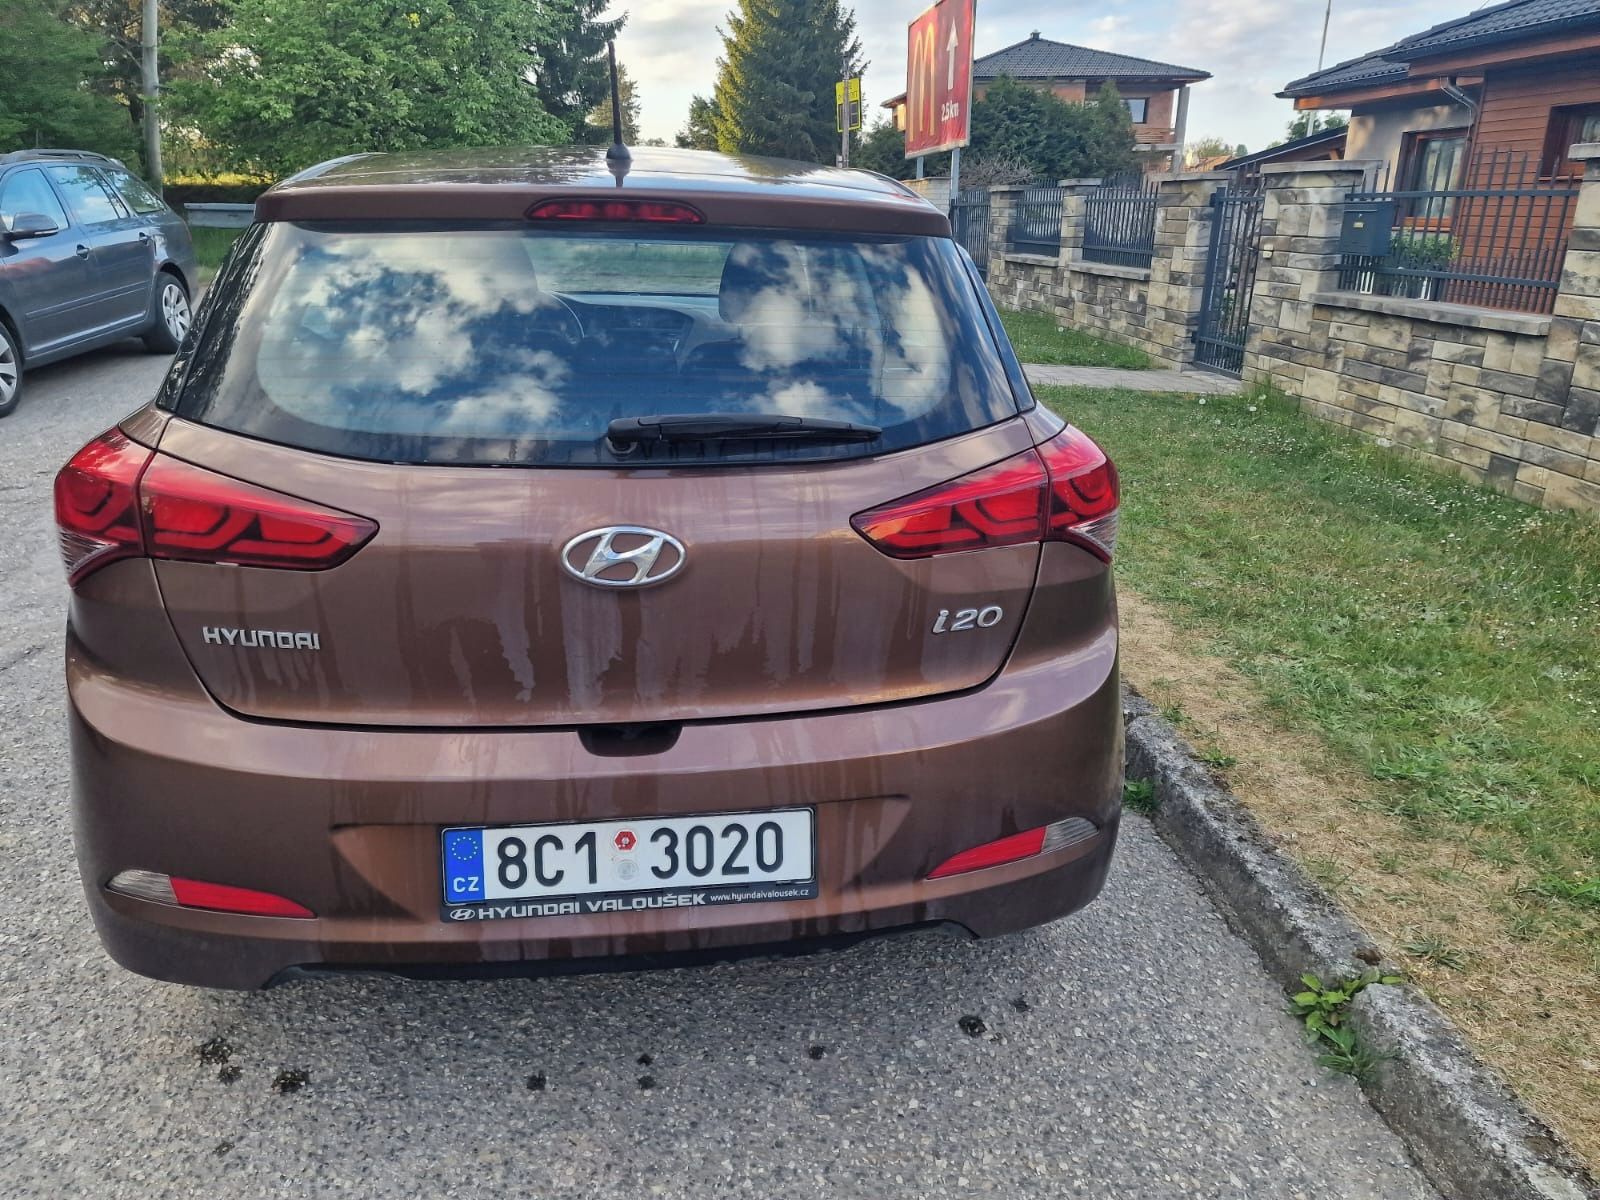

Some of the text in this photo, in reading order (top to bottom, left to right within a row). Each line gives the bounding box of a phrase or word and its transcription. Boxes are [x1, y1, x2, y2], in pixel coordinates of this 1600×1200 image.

[932, 606, 1003, 633] i20
[202, 626, 320, 649] HYUNDAI
[497, 821, 784, 889] 8C1 3020
[453, 876, 480, 893] CZ
[478, 889, 809, 919] HYUNDAI VALOUŠEK www.hyundaivalousek.cz
